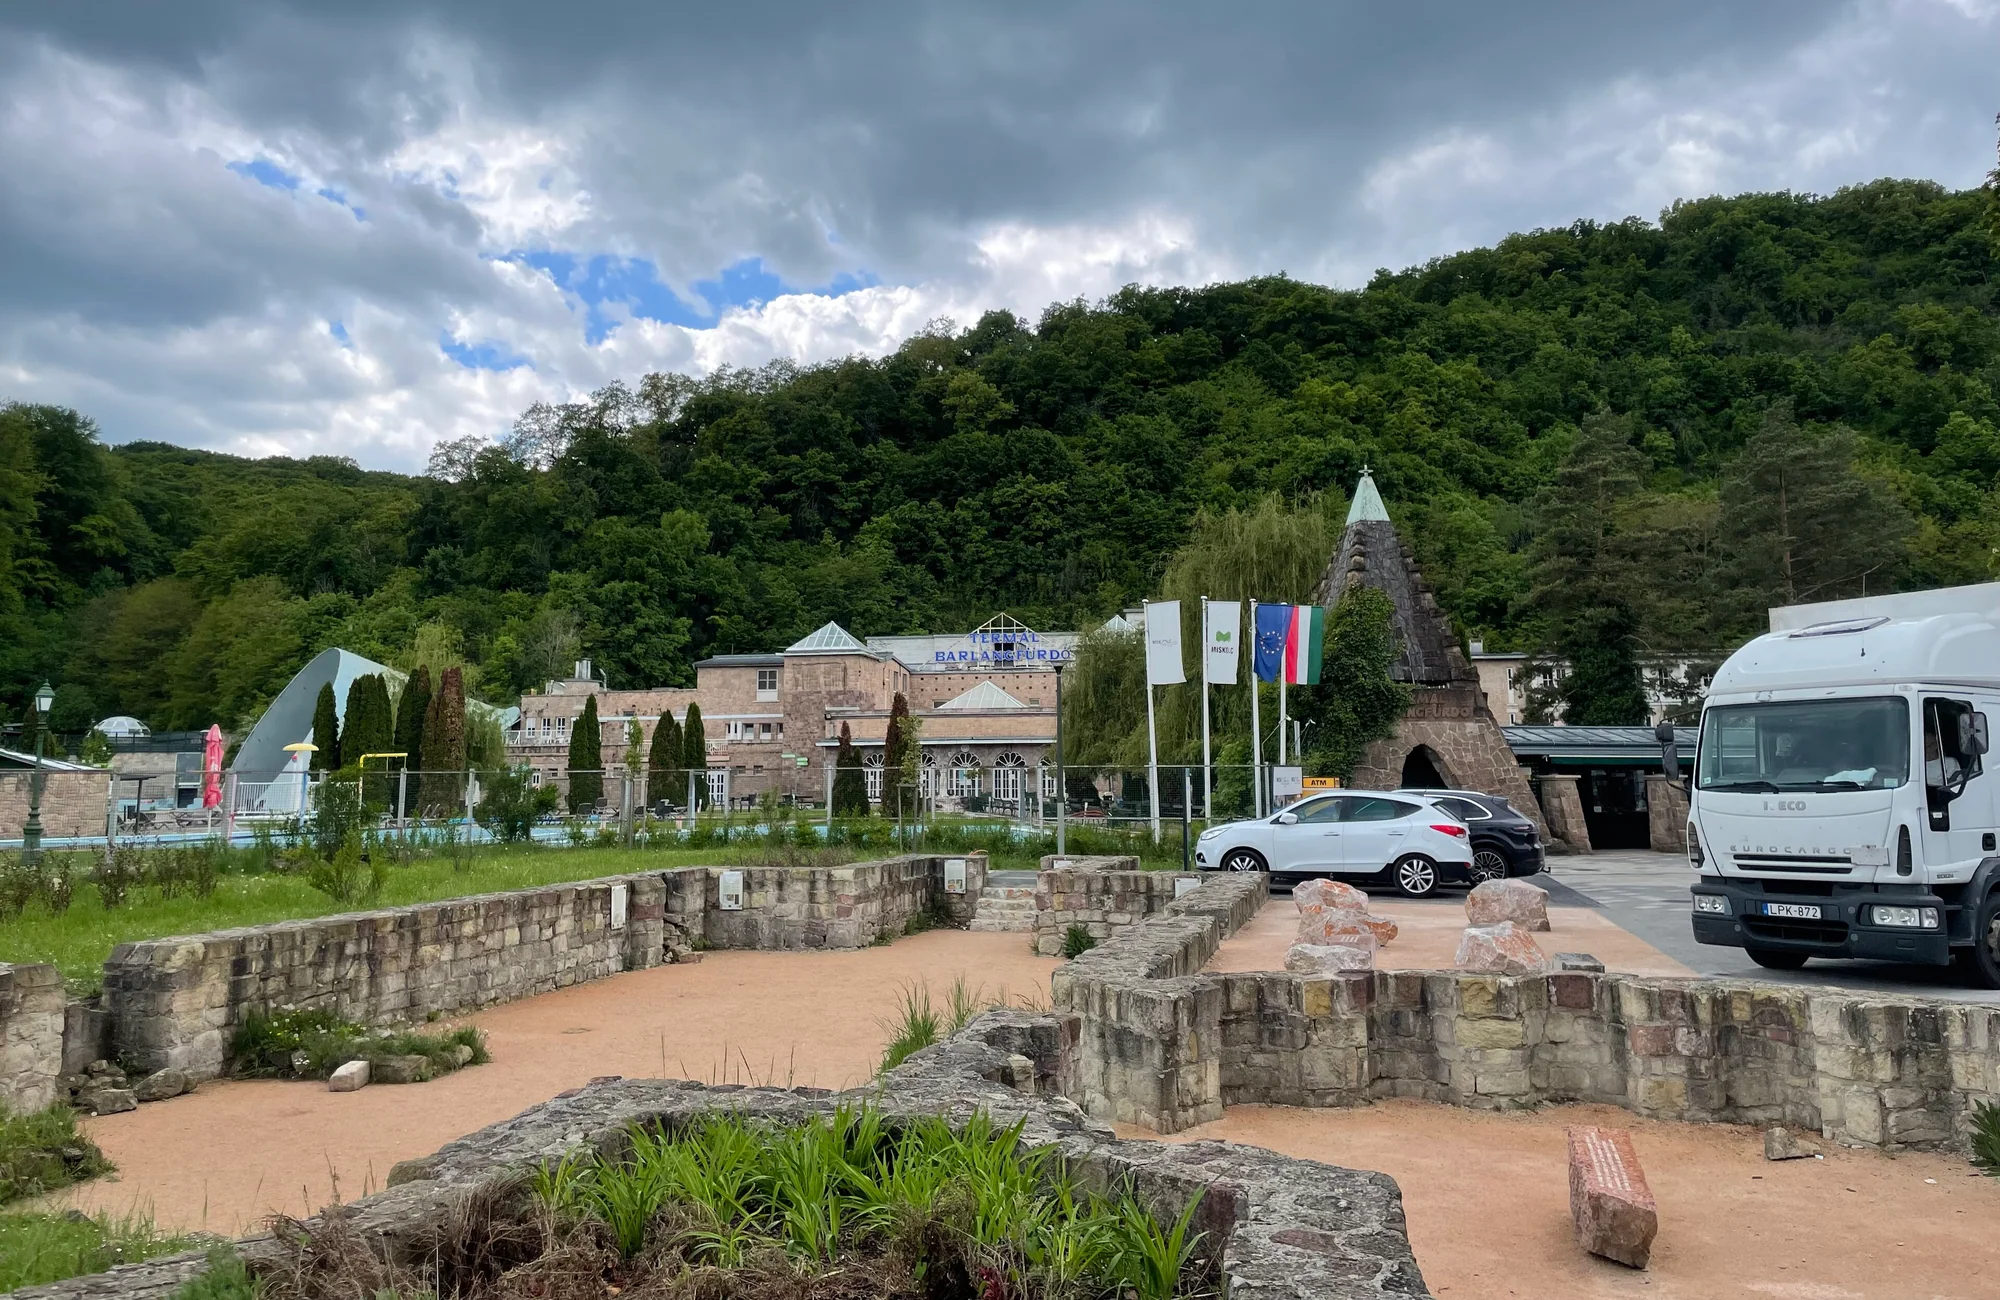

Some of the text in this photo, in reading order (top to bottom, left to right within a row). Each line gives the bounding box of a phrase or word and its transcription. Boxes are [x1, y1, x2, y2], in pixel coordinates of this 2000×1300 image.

[970, 631, 1040, 643] TERMÁL
[1763, 800, 1806, 811] IECO
[1730, 845, 1852, 855] EUROCARGO
[1769, 904, 1818, 918] LPK-872
